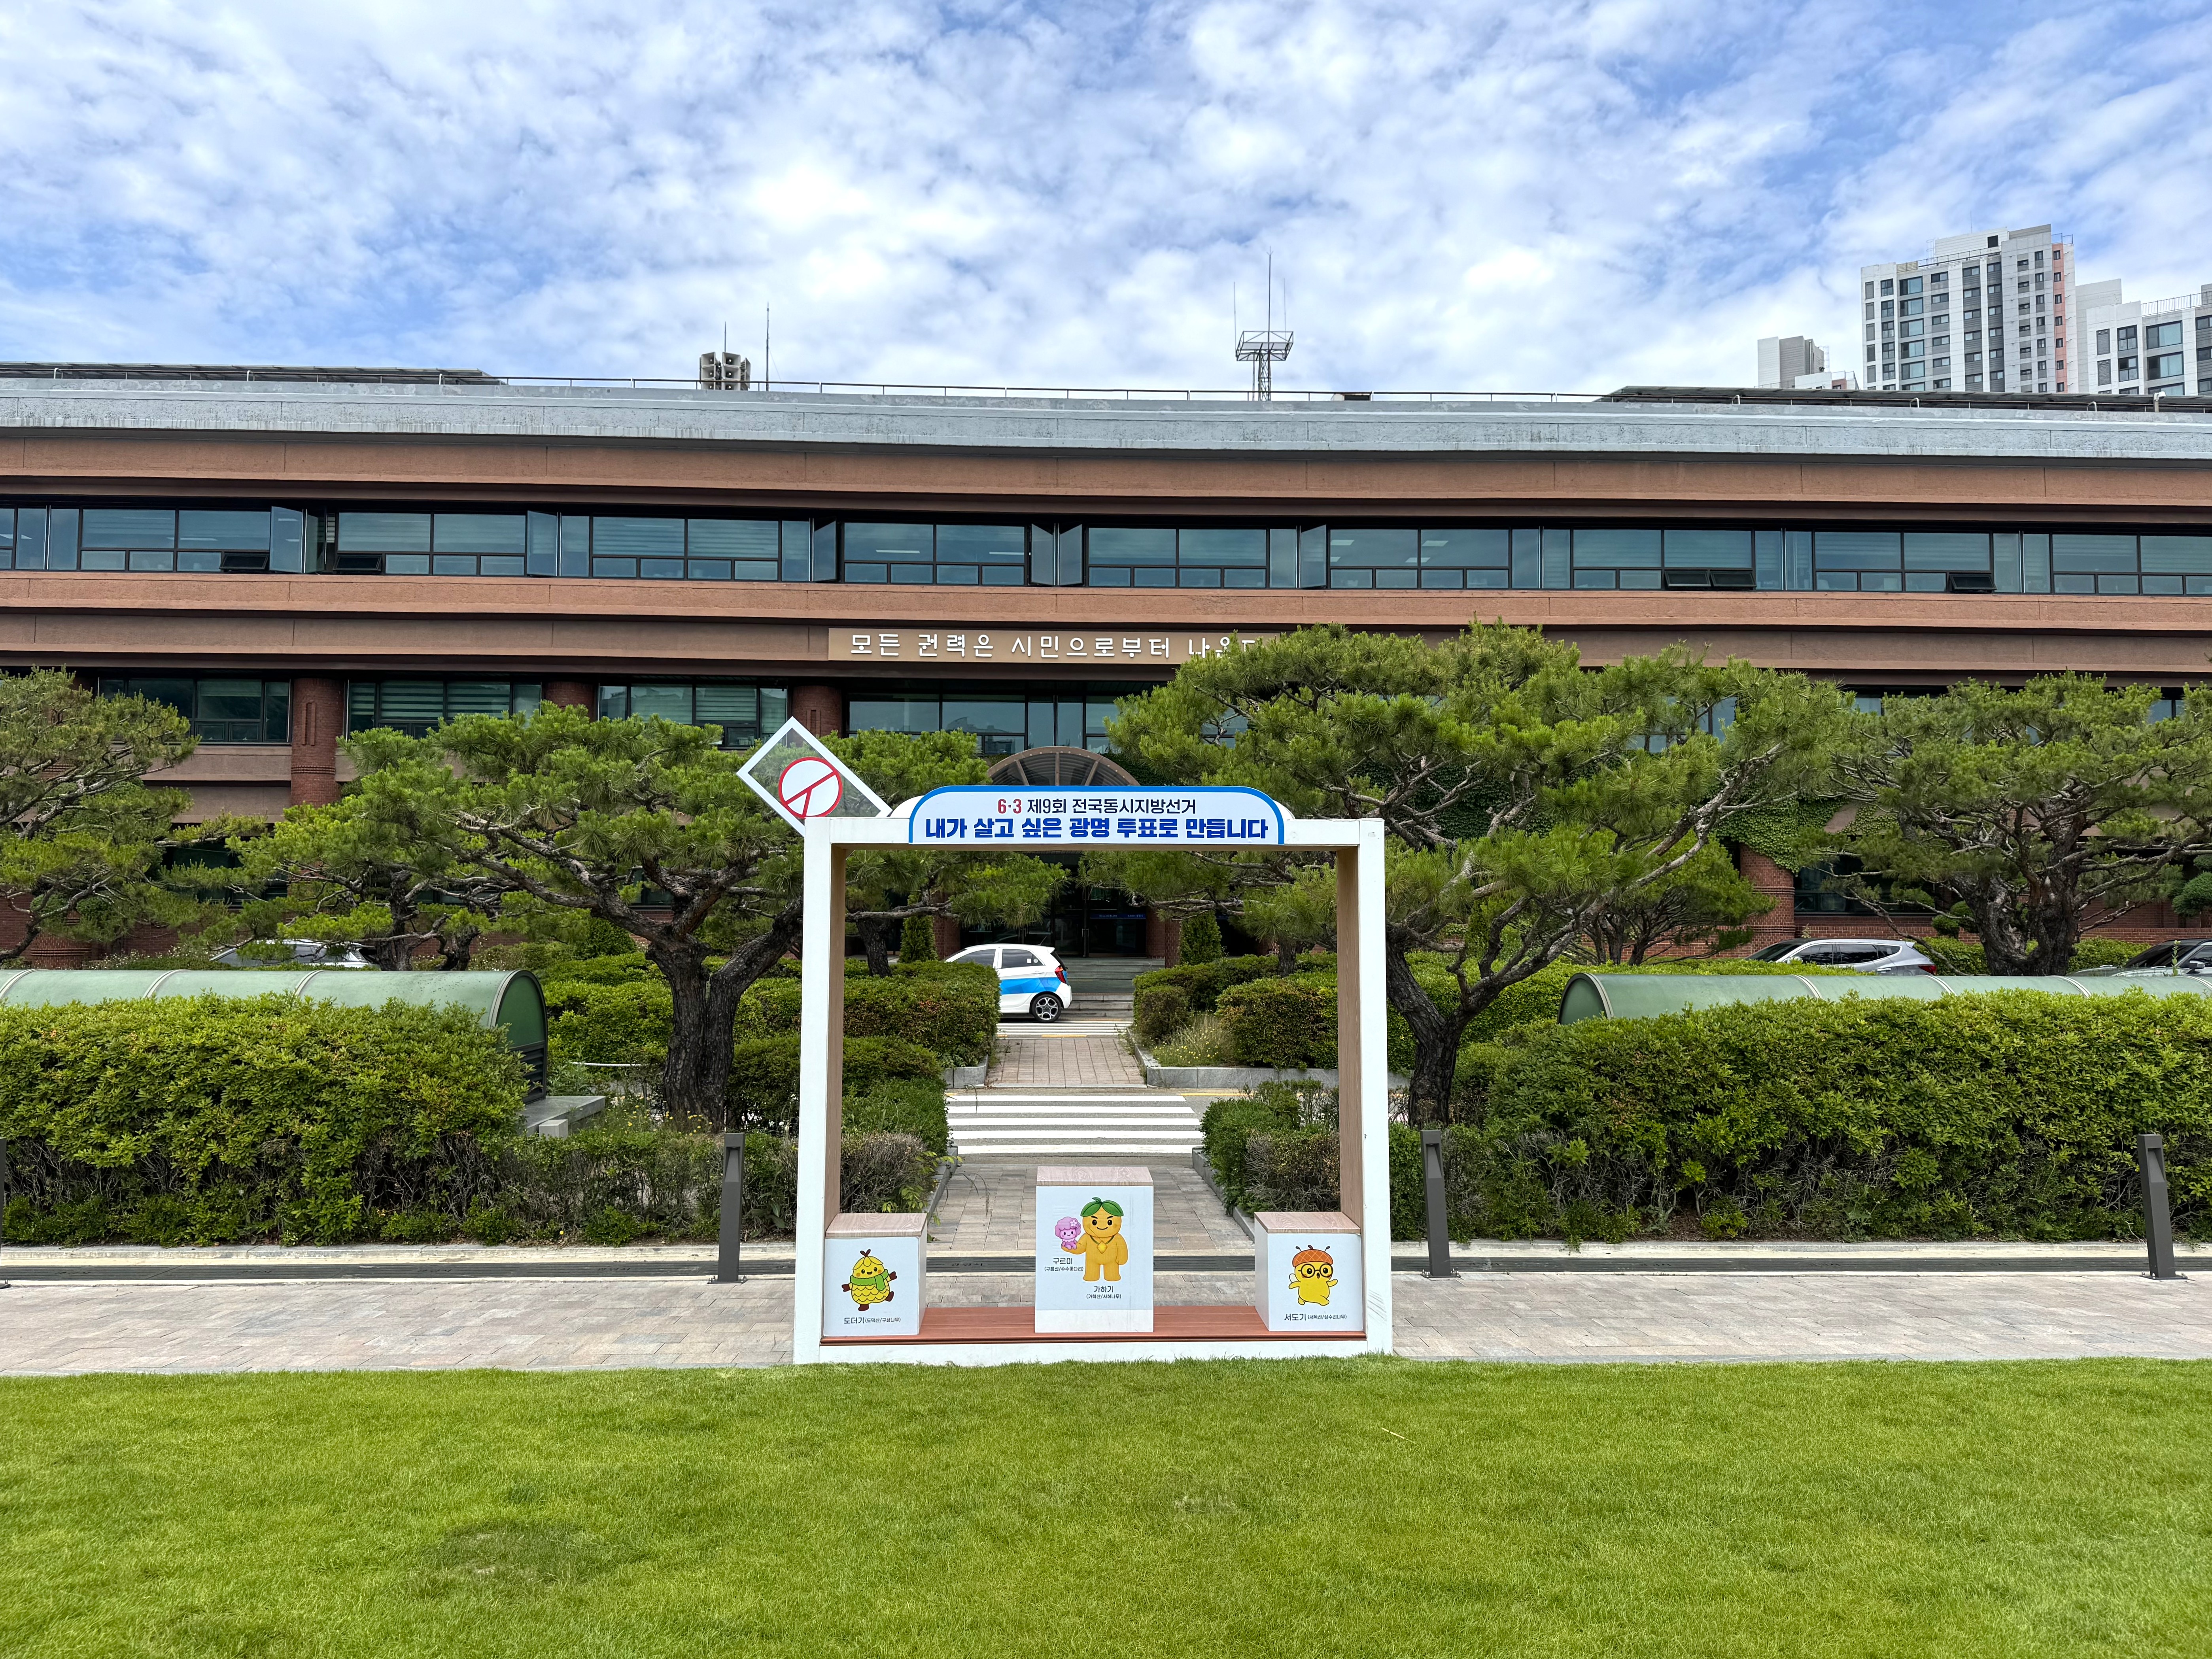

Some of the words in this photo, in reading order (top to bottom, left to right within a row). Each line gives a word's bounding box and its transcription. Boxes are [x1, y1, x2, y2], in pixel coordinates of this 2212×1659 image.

[851, 634, 900, 656] 모든
[918, 634, 993, 657] 권력은
[1011, 636, 1169, 658] 시민으로부터
[1189, 637, 1255, 658] 나온
[1027, 798, 1066, 814] 제9회
[1072, 799, 1196, 814] 전국동시지방선거
[926, 818, 968, 838] 내가
[974, 818, 1014, 838] 살고
[1021, 818, 1062, 838] 싶은
[1069, 818, 1110, 838] 광명
[1117, 818, 1178, 838] 투표로
[1186, 818, 1268, 839] 만듭니다
